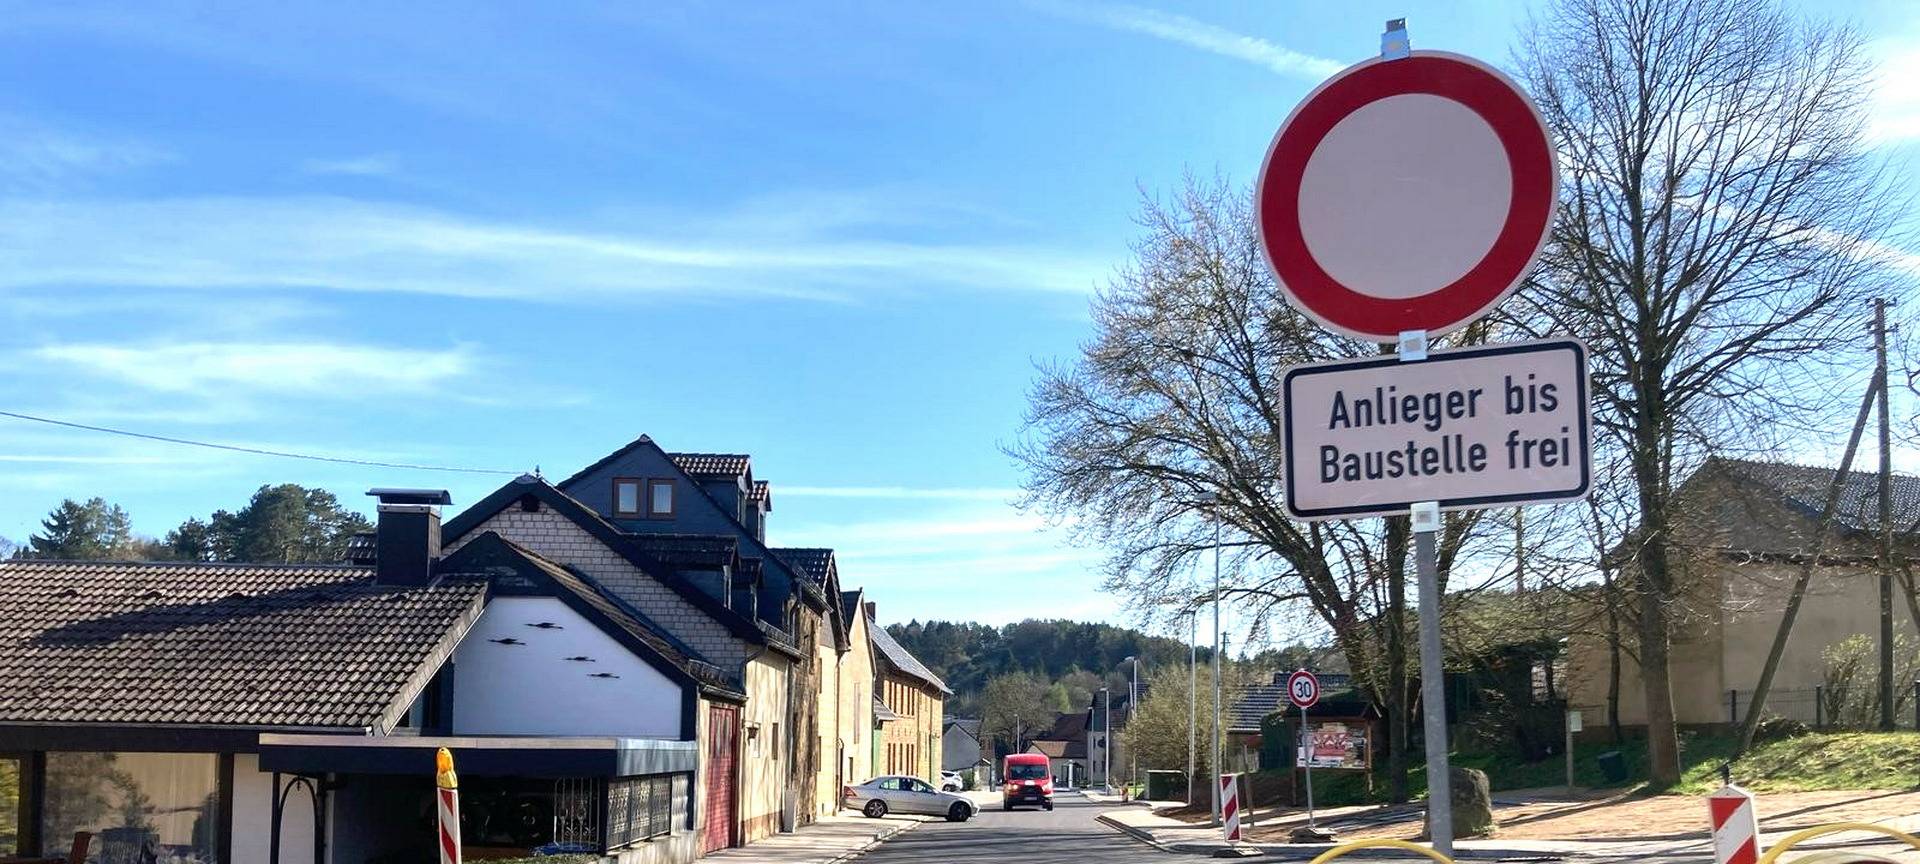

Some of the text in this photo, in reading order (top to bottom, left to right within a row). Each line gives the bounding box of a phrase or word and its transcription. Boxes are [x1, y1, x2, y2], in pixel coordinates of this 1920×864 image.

[1328, 374, 1558, 431] Anlieger bis
[1320, 426, 1570, 483] Baustelle frei
[1295, 681, 1312, 698] 30
